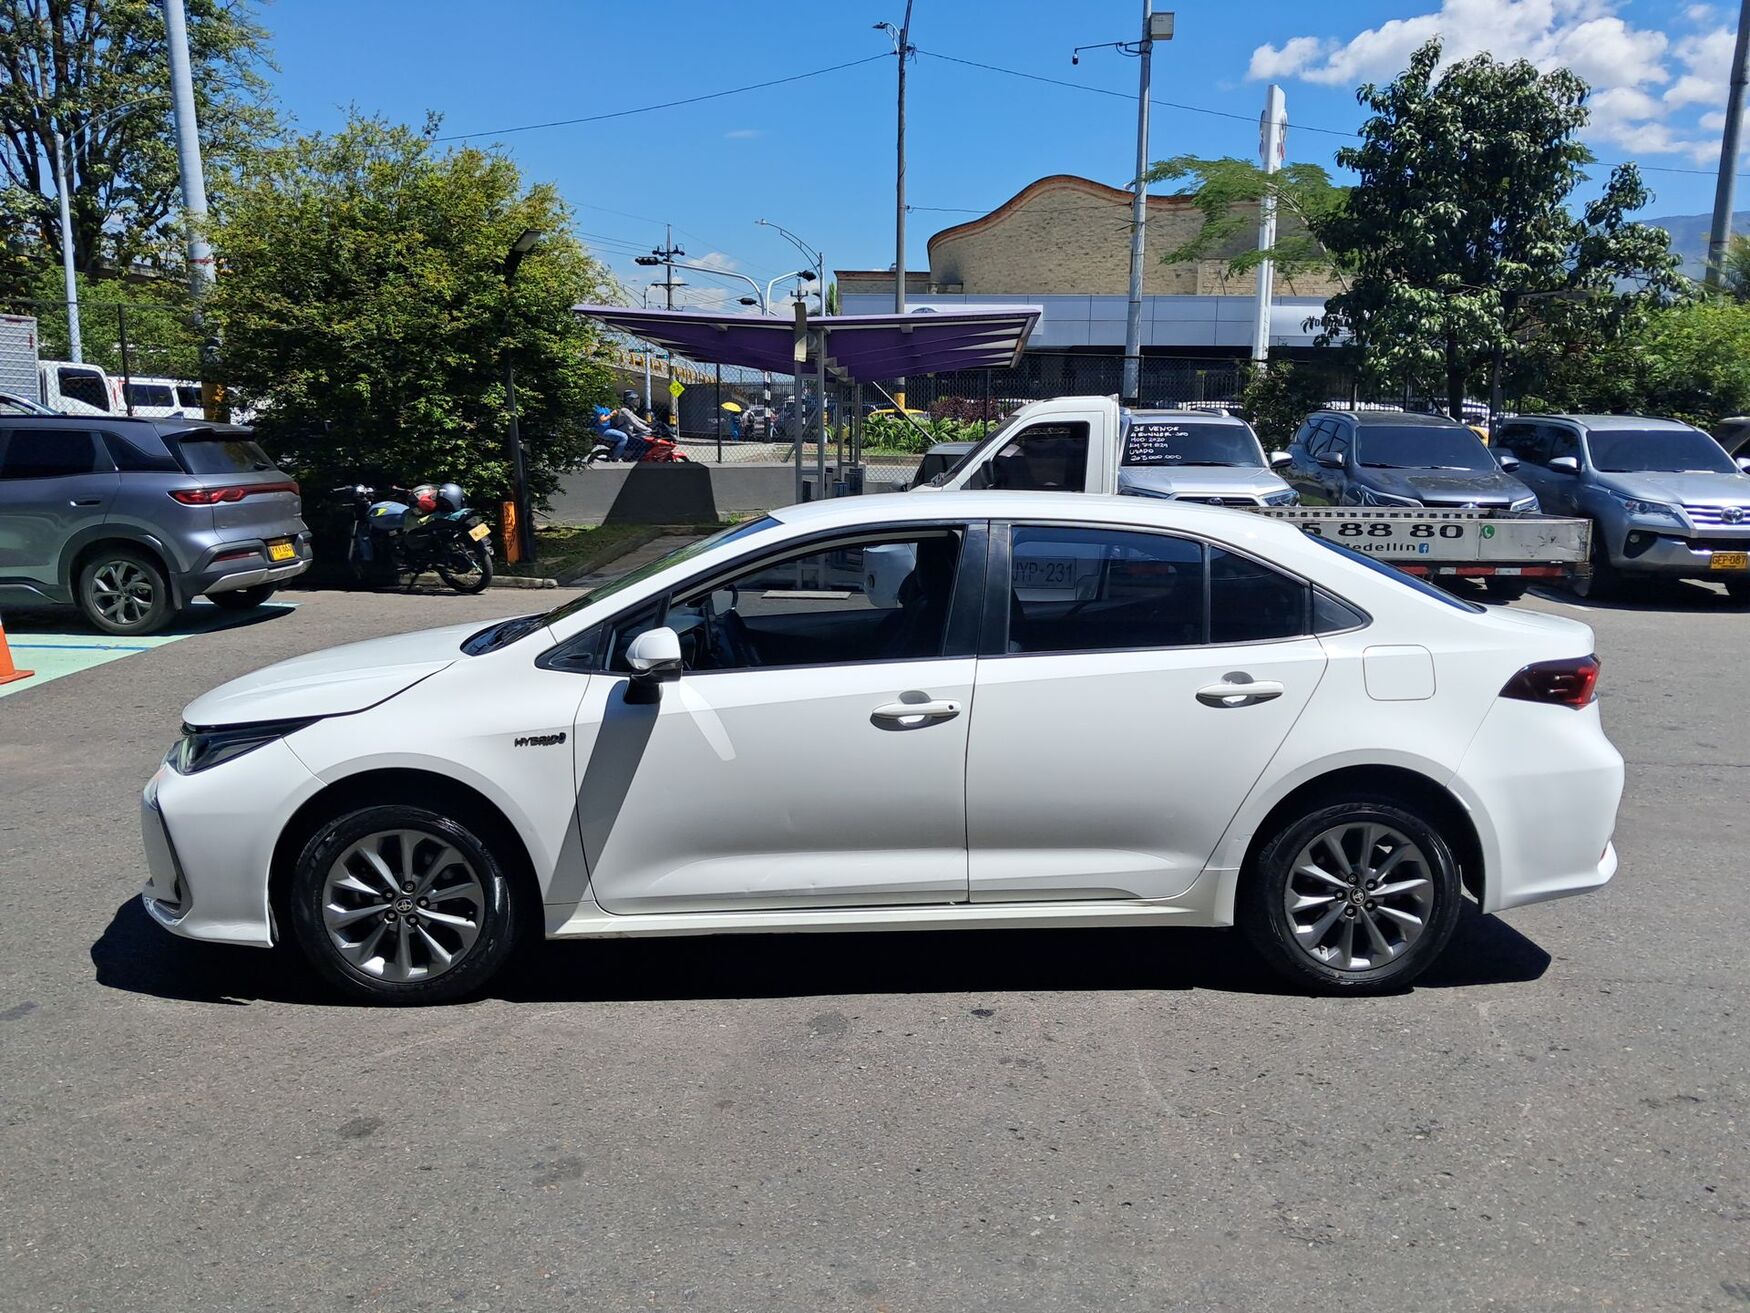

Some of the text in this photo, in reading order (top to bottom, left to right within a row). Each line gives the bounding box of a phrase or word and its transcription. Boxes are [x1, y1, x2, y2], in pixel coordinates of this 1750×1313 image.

[1338, 522, 1393, 537] 88
[1409, 524, 1464, 538] 80
[514, 734, 560, 746] HYBRID
